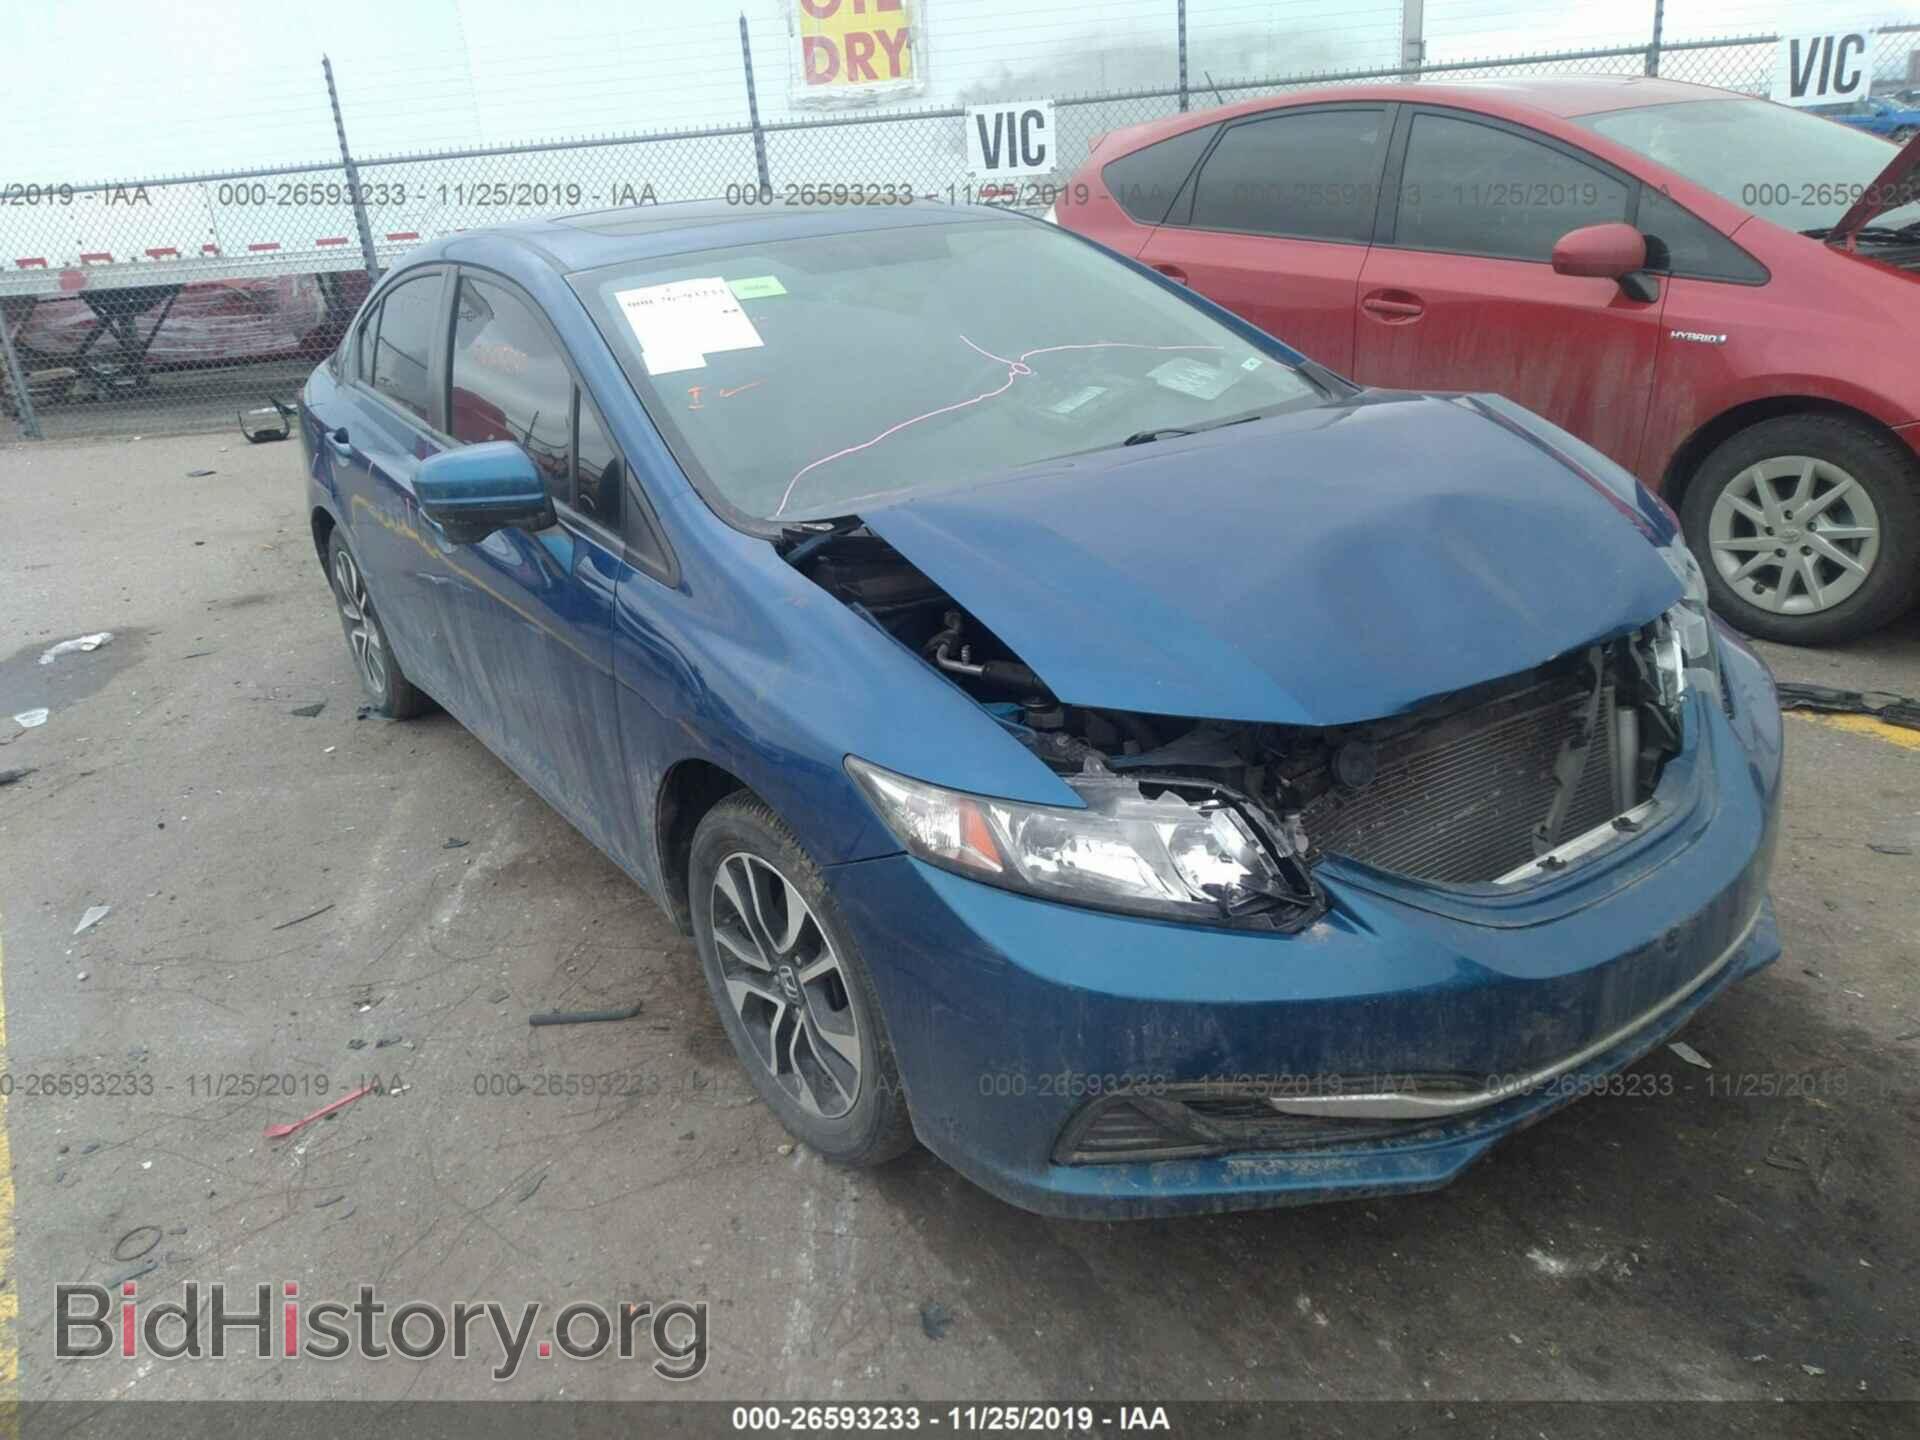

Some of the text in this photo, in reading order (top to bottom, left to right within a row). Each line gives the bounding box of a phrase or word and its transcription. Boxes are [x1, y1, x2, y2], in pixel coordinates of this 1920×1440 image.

[802, 26, 911, 86] DRY
[1789, 33, 1865, 97] VIC
[976, 109, 1045, 170] VIC
